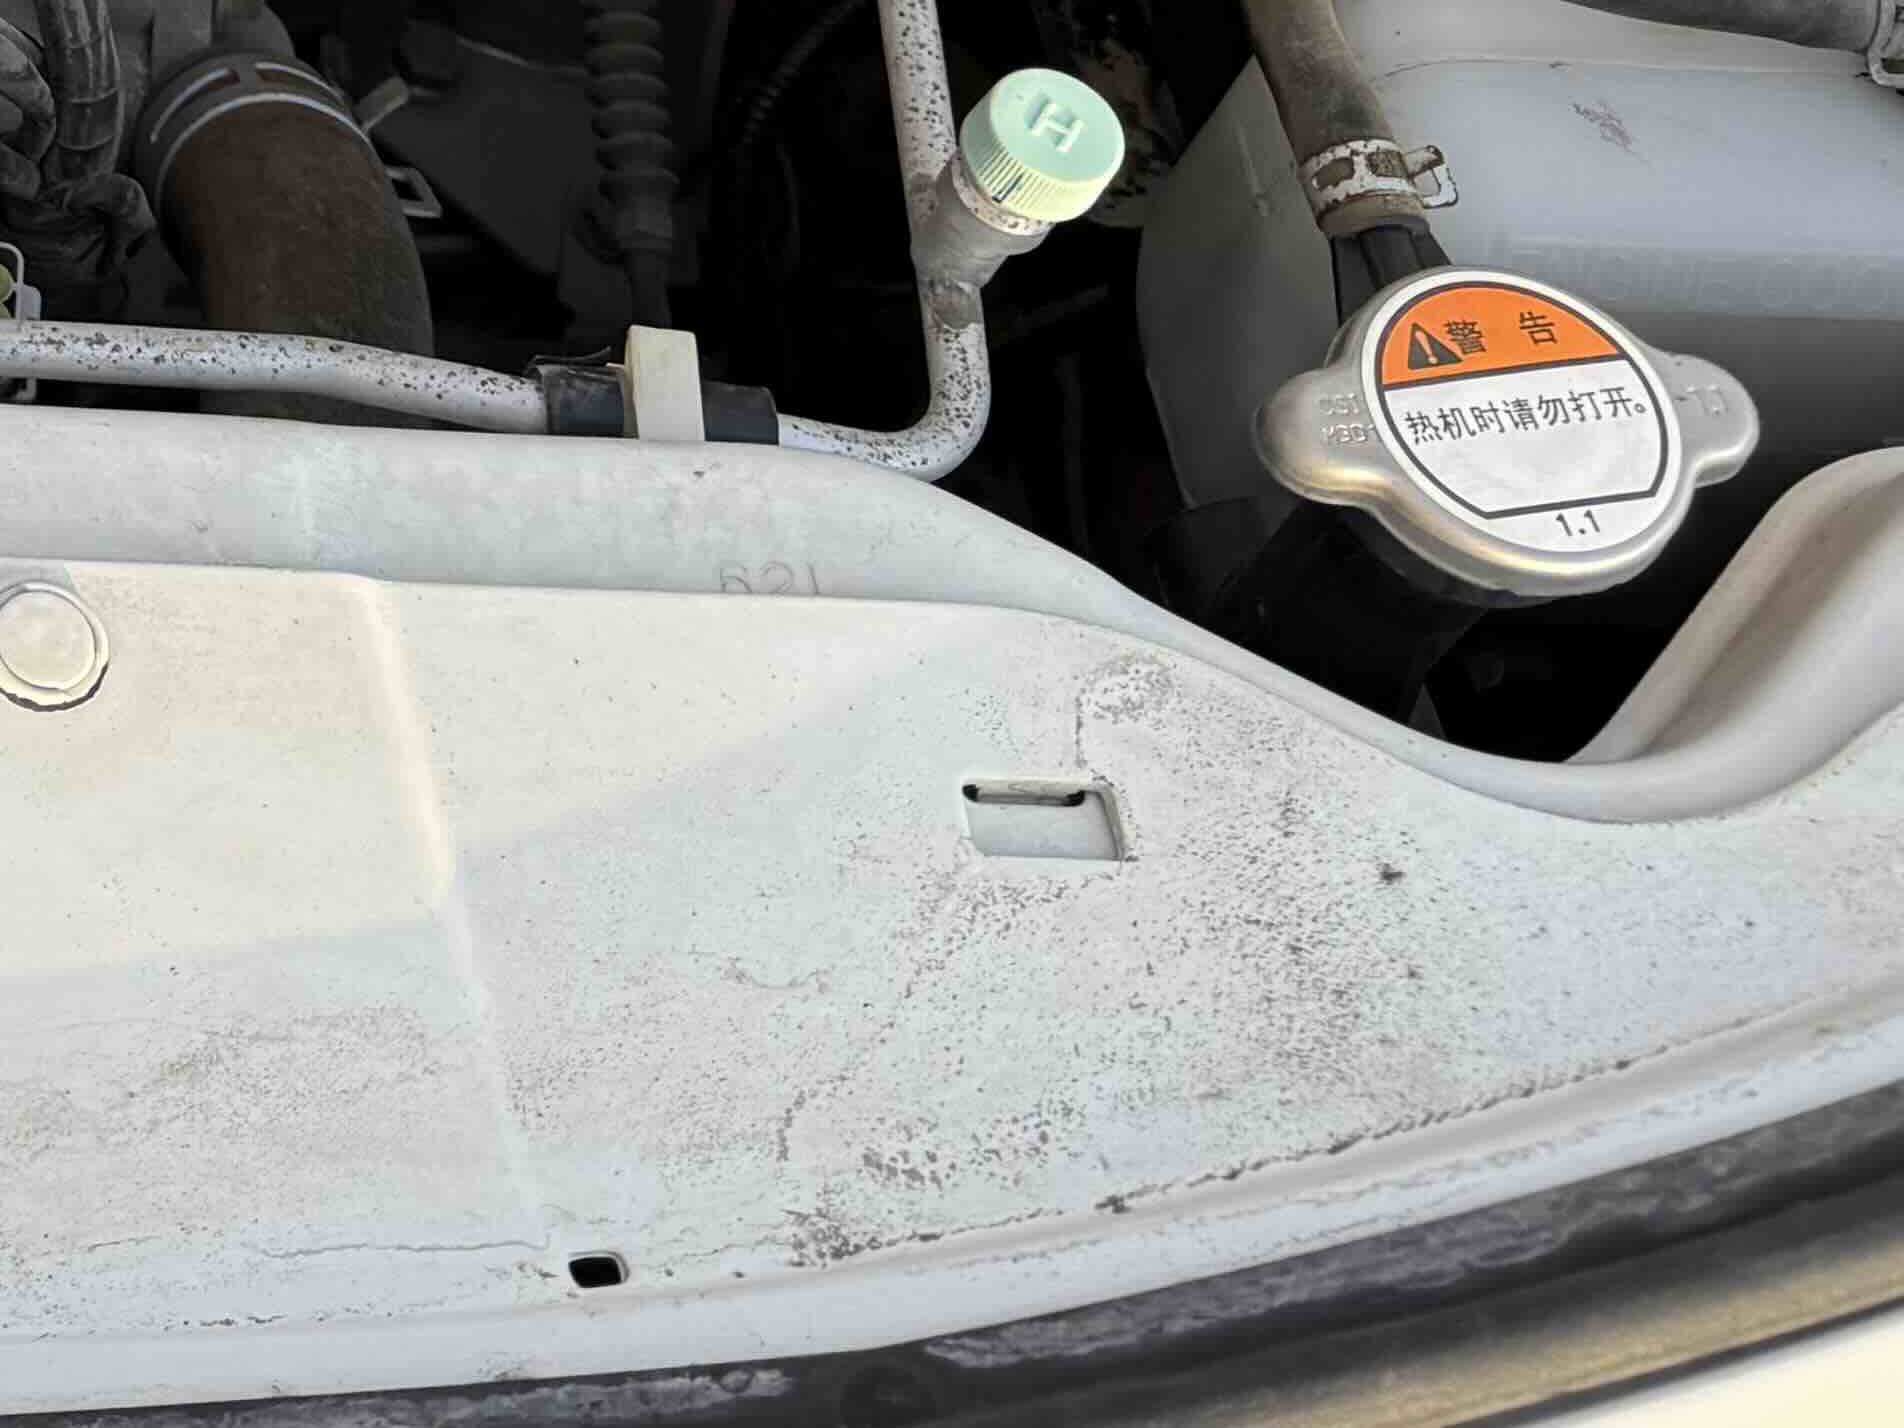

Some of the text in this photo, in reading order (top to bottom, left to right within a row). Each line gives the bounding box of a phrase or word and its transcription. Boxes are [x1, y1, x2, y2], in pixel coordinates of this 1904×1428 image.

[1028, 95, 1084, 153] H
[1444, 310, 1559, 357] 警告
[1404, 385, 1649, 445] 热机时请勿打开。
[1555, 509, 1602, 538] 1.1
